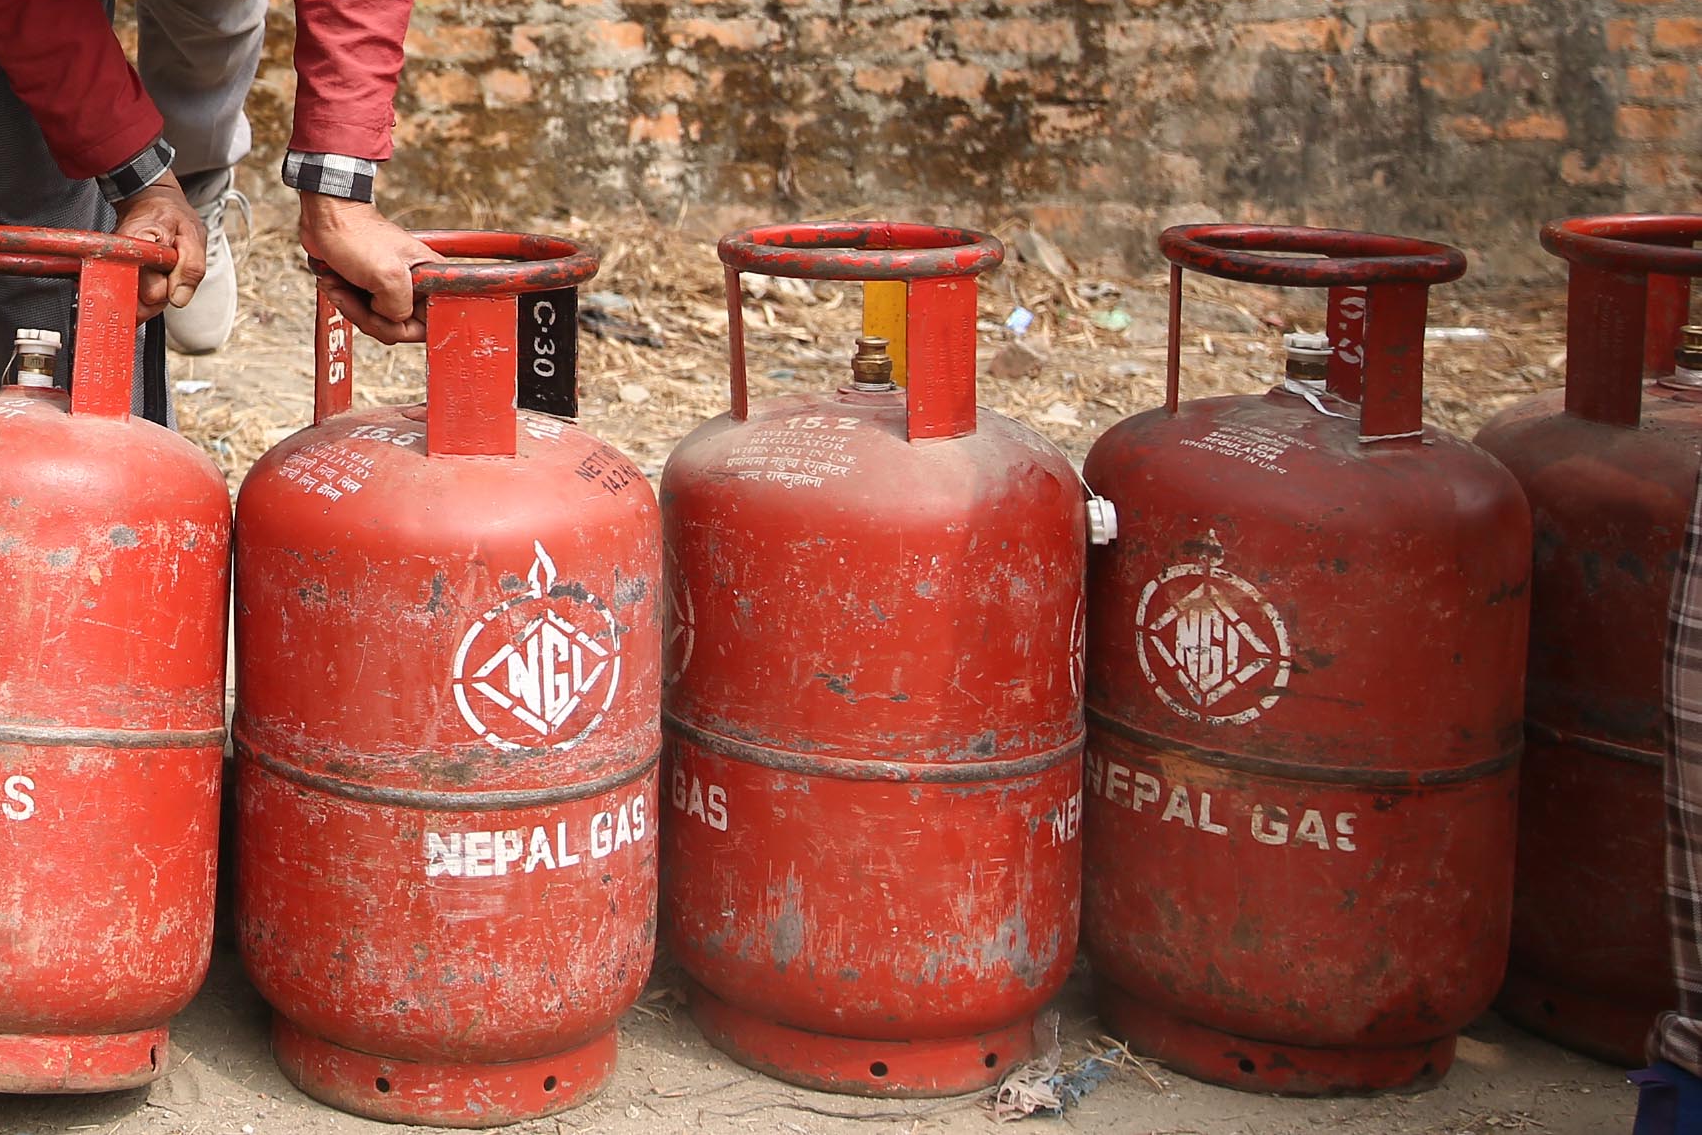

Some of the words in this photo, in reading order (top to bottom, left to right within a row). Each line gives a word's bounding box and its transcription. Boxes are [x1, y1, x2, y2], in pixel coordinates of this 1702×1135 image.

[786, 416, 861, 431] 15.2
[749, 437, 845, 452] REGULATOR
[1179, 438, 1217, 452] WHEN
[1215, 446, 1244, 459] NOT
[1243, 454, 1258, 464] IN
[1201, 435, 1278, 462] REGULATOR
[1208, 431, 1257, 447] SWITCH
[347, 451, 376, 469] SEAL
[574, 450, 610, 483] NETT
[773, 446, 806, 456] NOT
[808, 448, 826, 459] IN
[828, 451, 858, 466] USE
[507, 621, 583, 723] NGI
[671, 768, 729, 832] GAS
[1085, 750, 1228, 836] NEPAL
[1250, 803, 1358, 852] GAS
[424, 819, 581, 878] NEPAL
[590, 794, 646, 860] GAS
